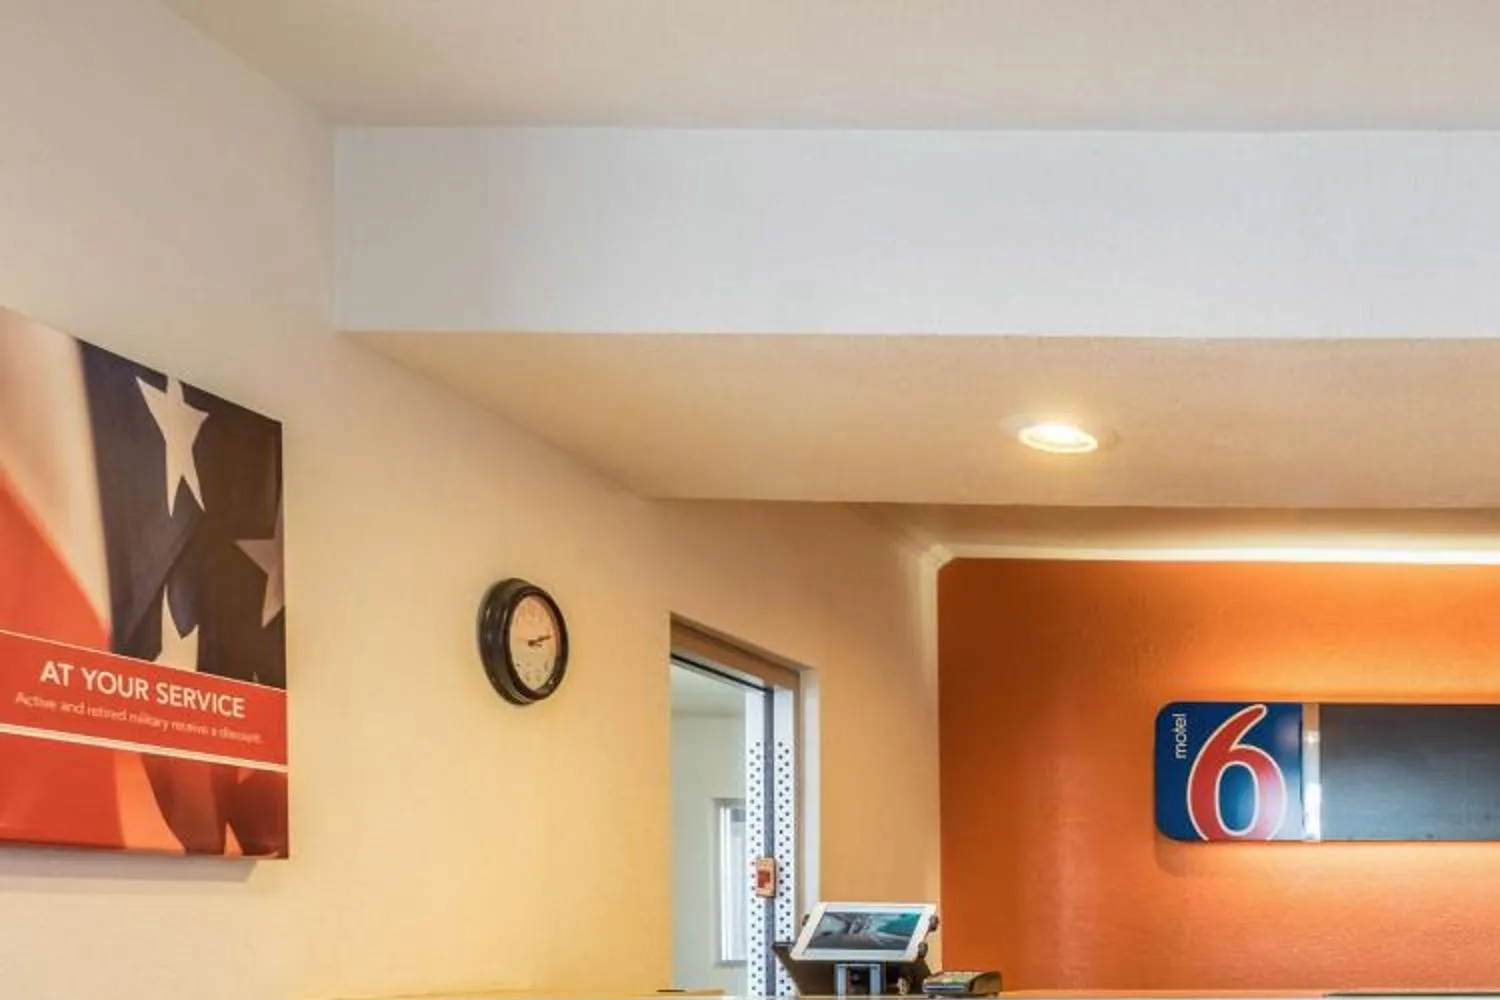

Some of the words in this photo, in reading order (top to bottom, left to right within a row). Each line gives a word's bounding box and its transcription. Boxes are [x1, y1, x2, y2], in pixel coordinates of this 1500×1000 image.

[15, 691, 57, 711] Active
[61, 701, 85, 716] and
[87, 706, 127, 721] retired
[128, 711, 169, 733] military
[40, 660, 75, 688] AT
[80, 667, 150, 701] YOUR
[155, 682, 246, 719] SERVICE
[1172, 712, 1188, 760] motel
[1187, 703, 1287, 841] 6
